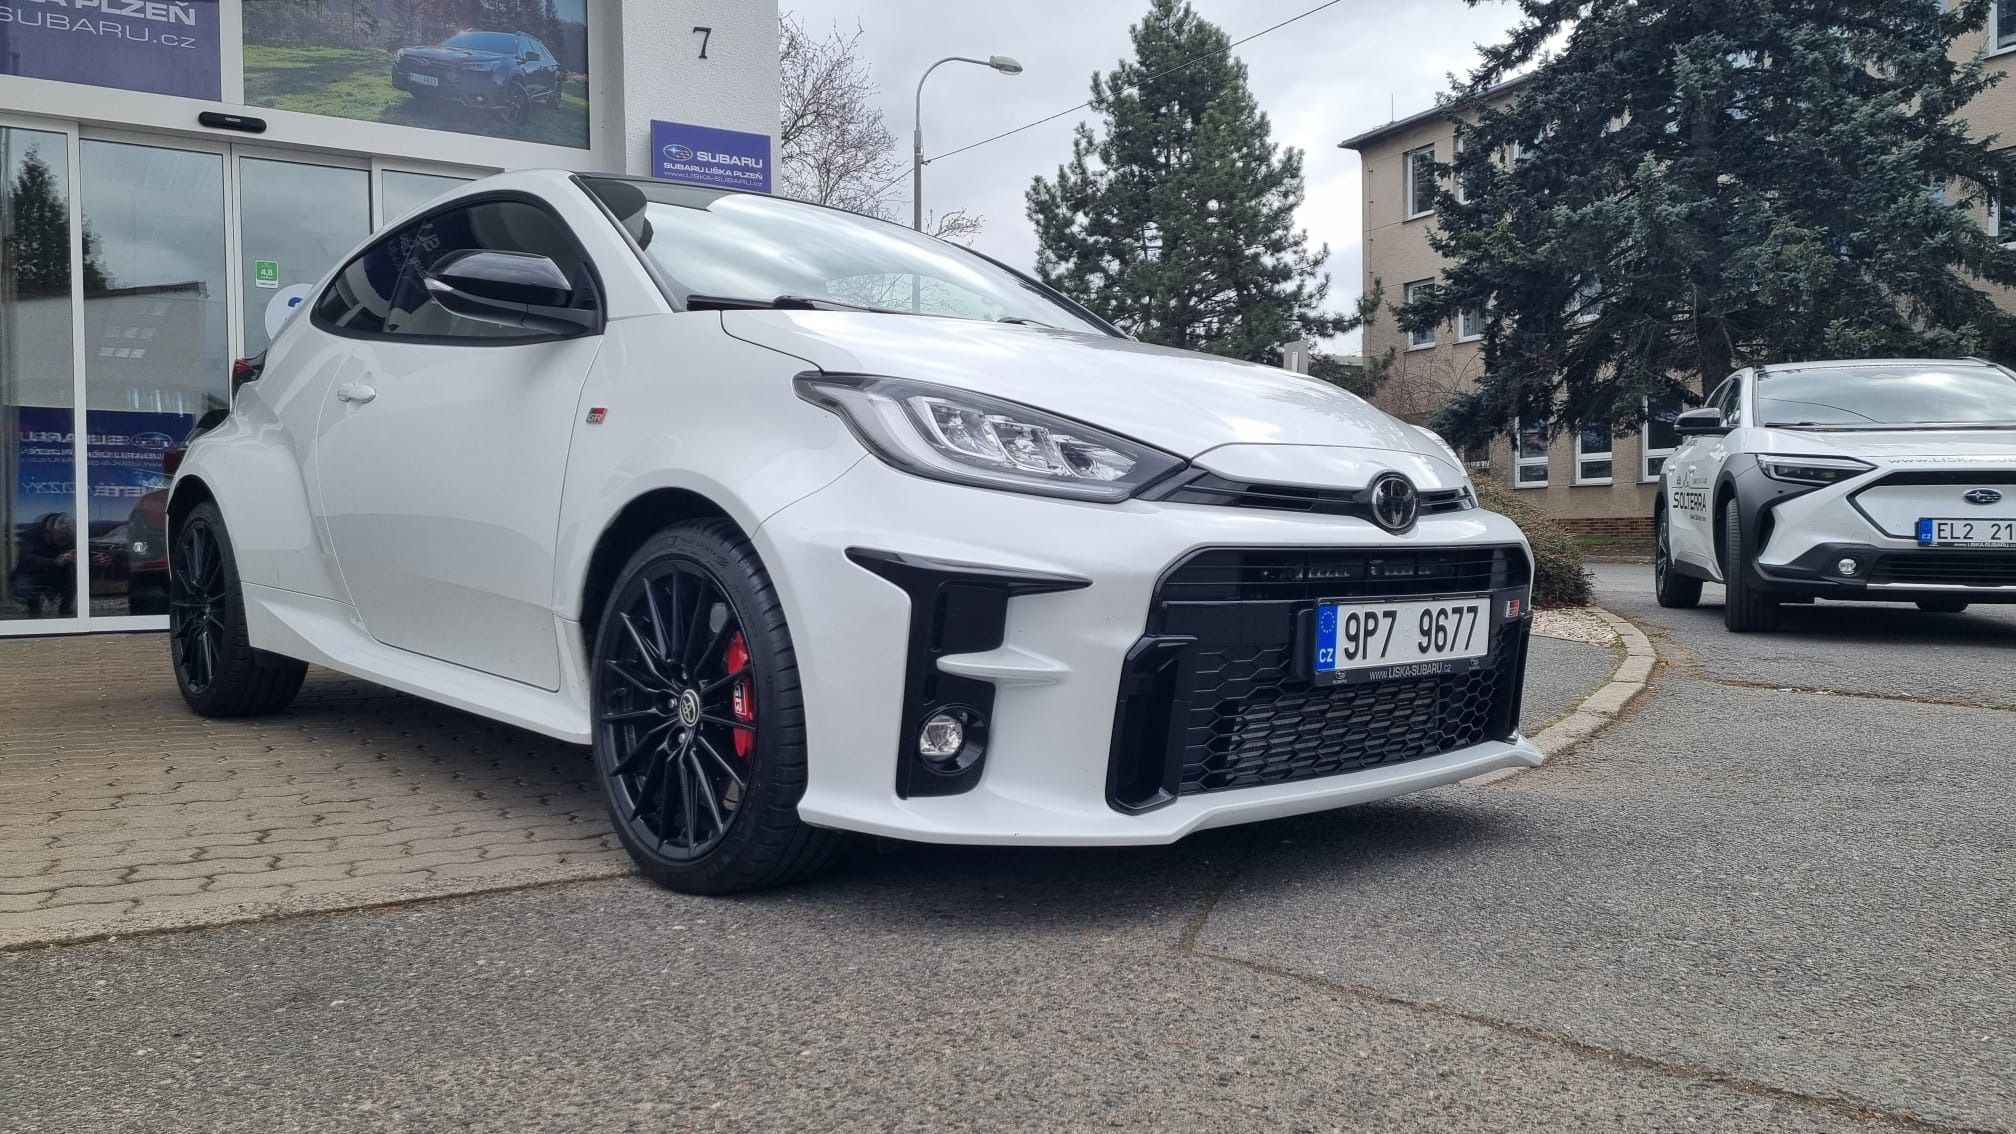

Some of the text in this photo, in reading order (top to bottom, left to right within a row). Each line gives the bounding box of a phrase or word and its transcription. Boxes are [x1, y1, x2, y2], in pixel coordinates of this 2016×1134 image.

[692, 26, 712, 60] 7
[696, 151, 763, 168] SUBARU
[663, 162, 763, 180] SUBARU LIŠKA PLZEŇ
[1673, 491, 1707, 512] SOLTERRA
[1937, 522, 1974, 540] EL2
[1990, 523, 2013, 541] 21
[1319, 605, 1479, 663] CZ 9P7 9677
